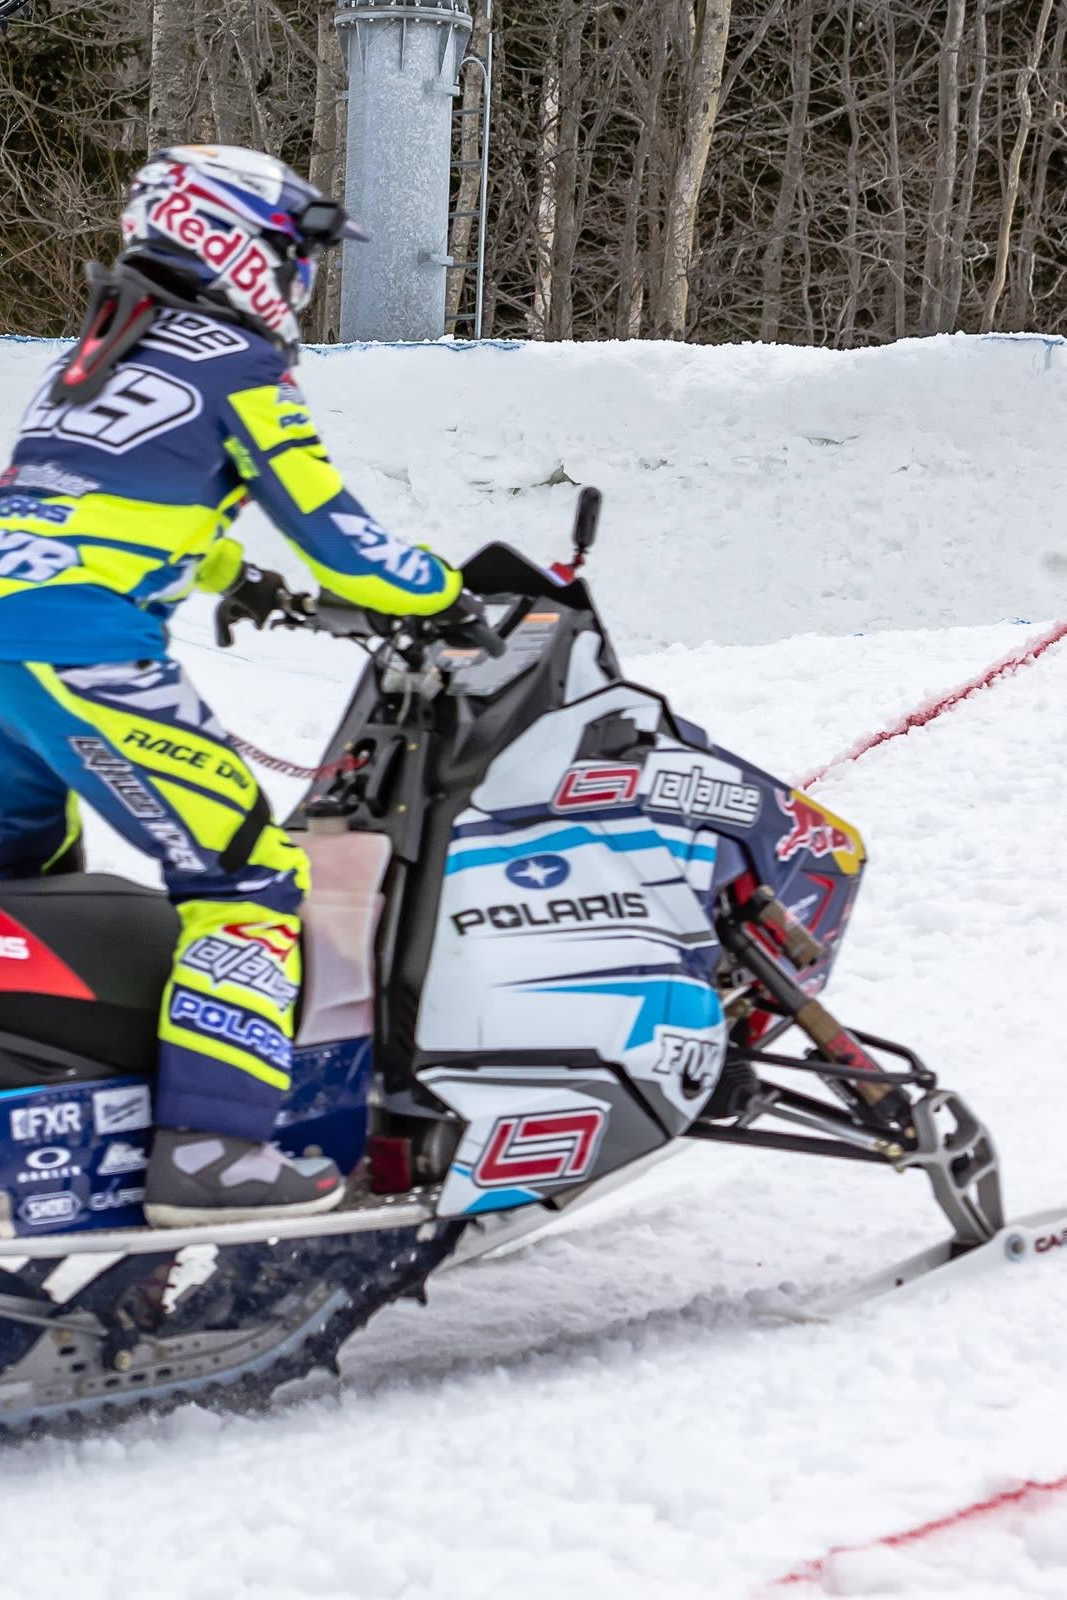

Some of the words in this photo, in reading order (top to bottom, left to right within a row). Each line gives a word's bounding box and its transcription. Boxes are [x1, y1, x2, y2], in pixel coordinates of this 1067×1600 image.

[152, 192, 244, 266] Red
[230, 246, 290, 331] Bull
[123, 728, 212, 770] RACE
[450, 892, 650, 937] POLARIS
[22, 1102, 82, 1140] FXR
